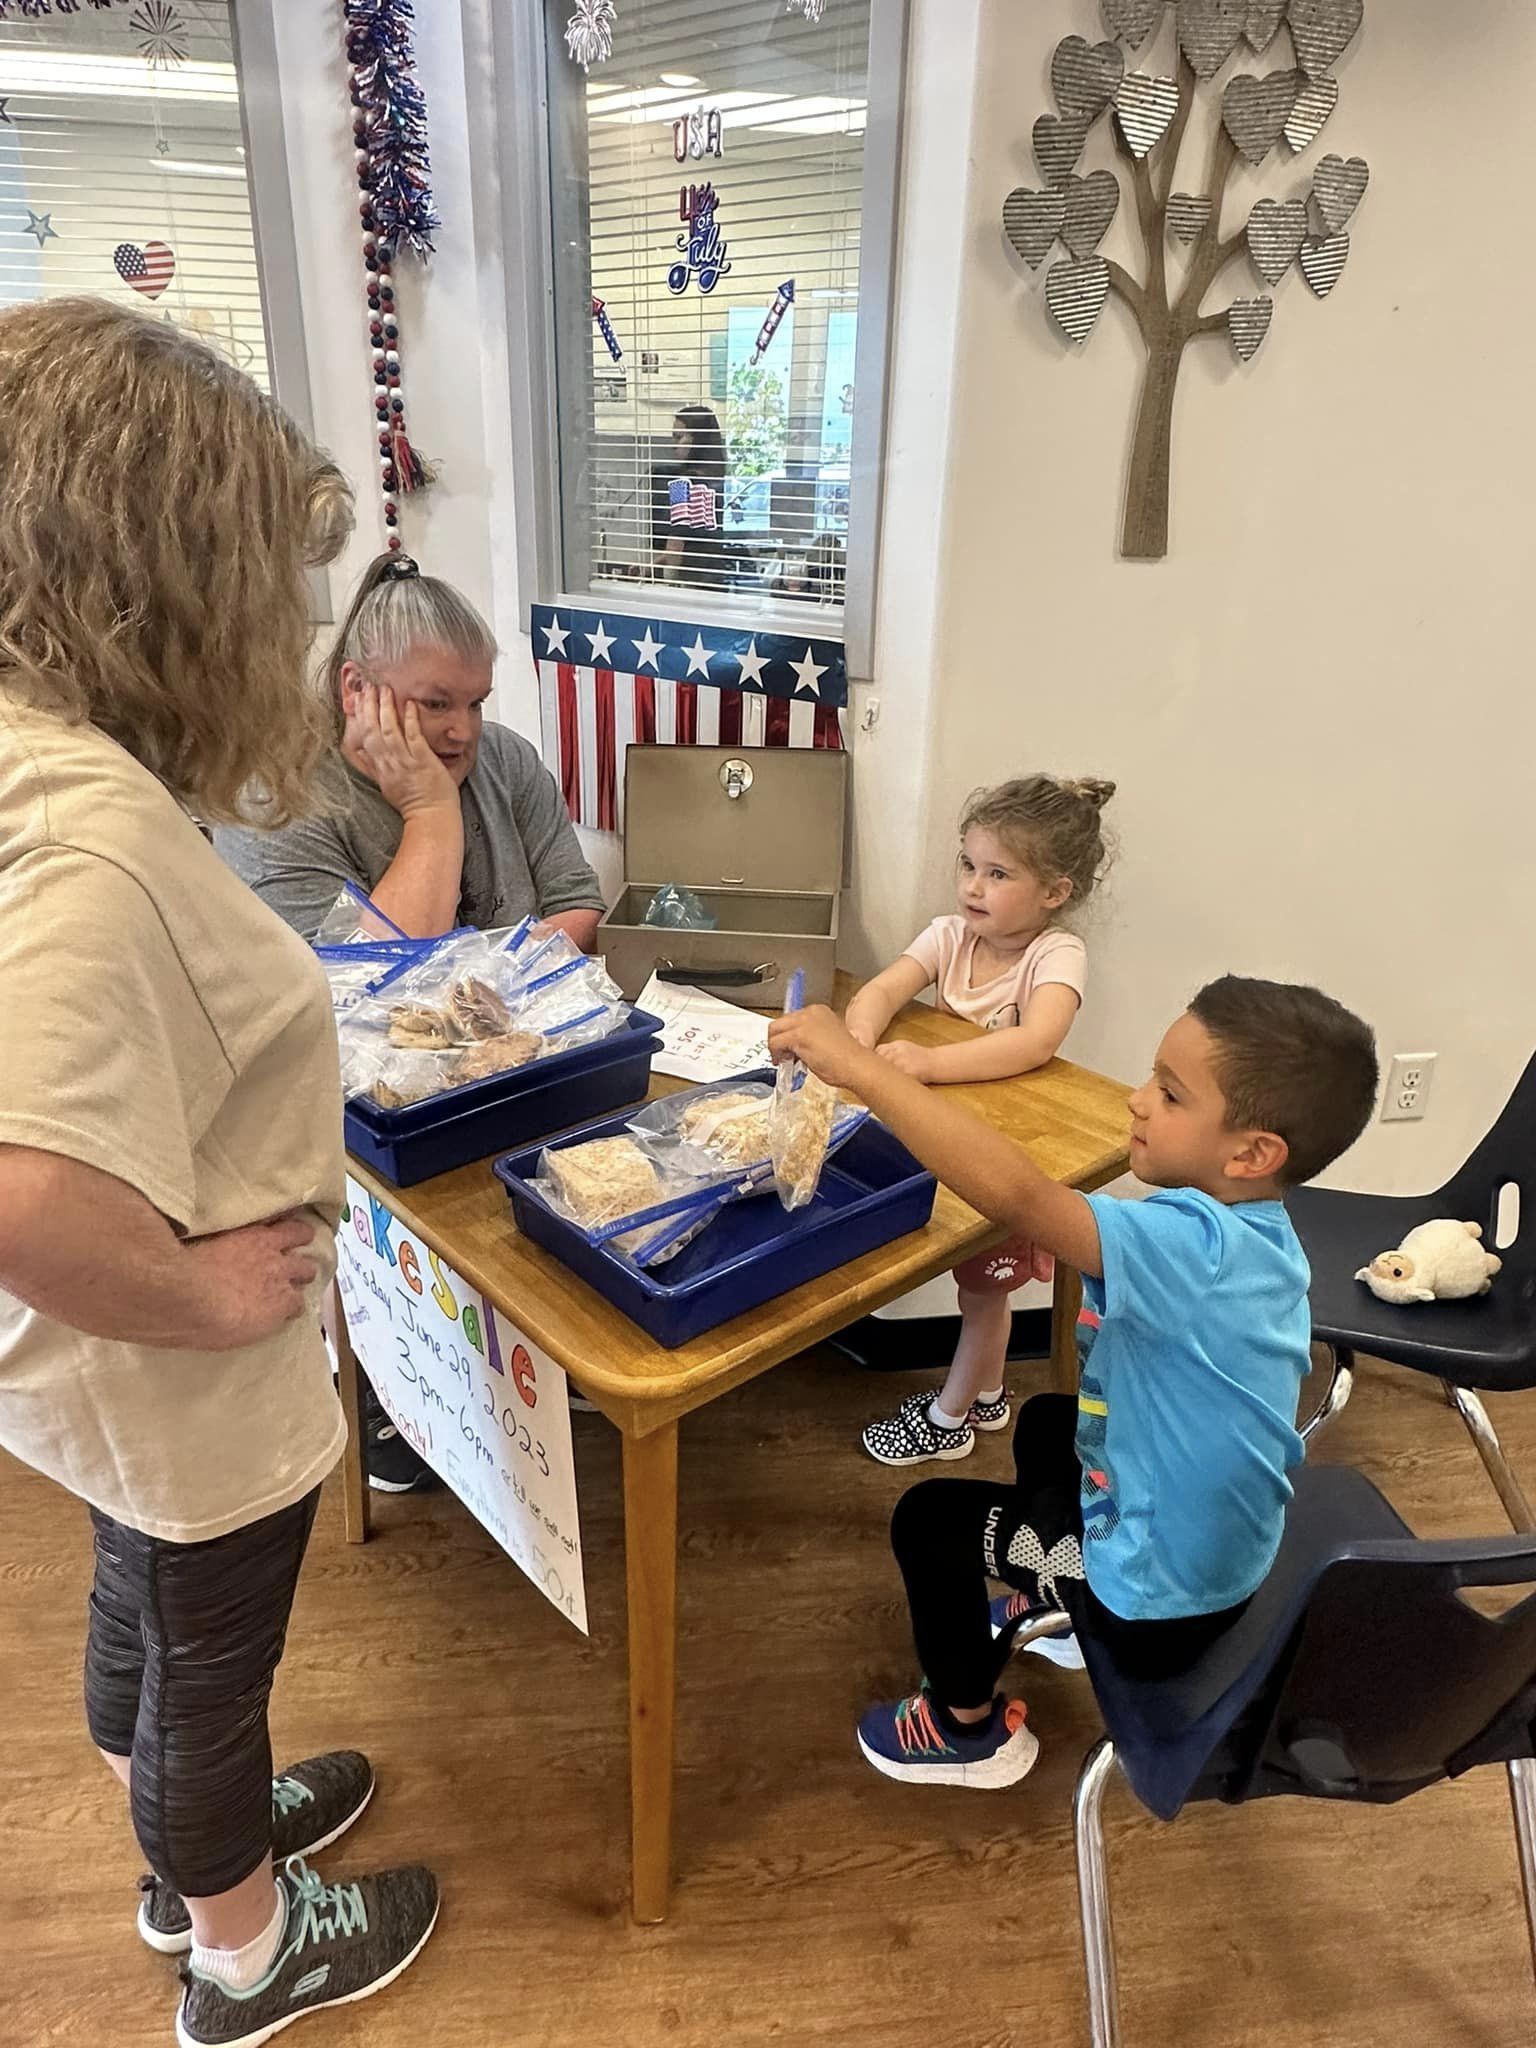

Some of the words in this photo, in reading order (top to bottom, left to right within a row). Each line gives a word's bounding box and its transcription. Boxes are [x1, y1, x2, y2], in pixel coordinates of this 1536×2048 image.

[672, 105, 723, 163] USA
[680, 181, 720, 236] 4th
[696, 213, 714, 231] OF
[667, 223, 731, 294] July
[338, 1232, 392, 1321] hursday
[395, 1287, 447, 1361] June
[483, 1384, 549, 1476] 2023
[983, 1506, 1003, 1578] UNDER
